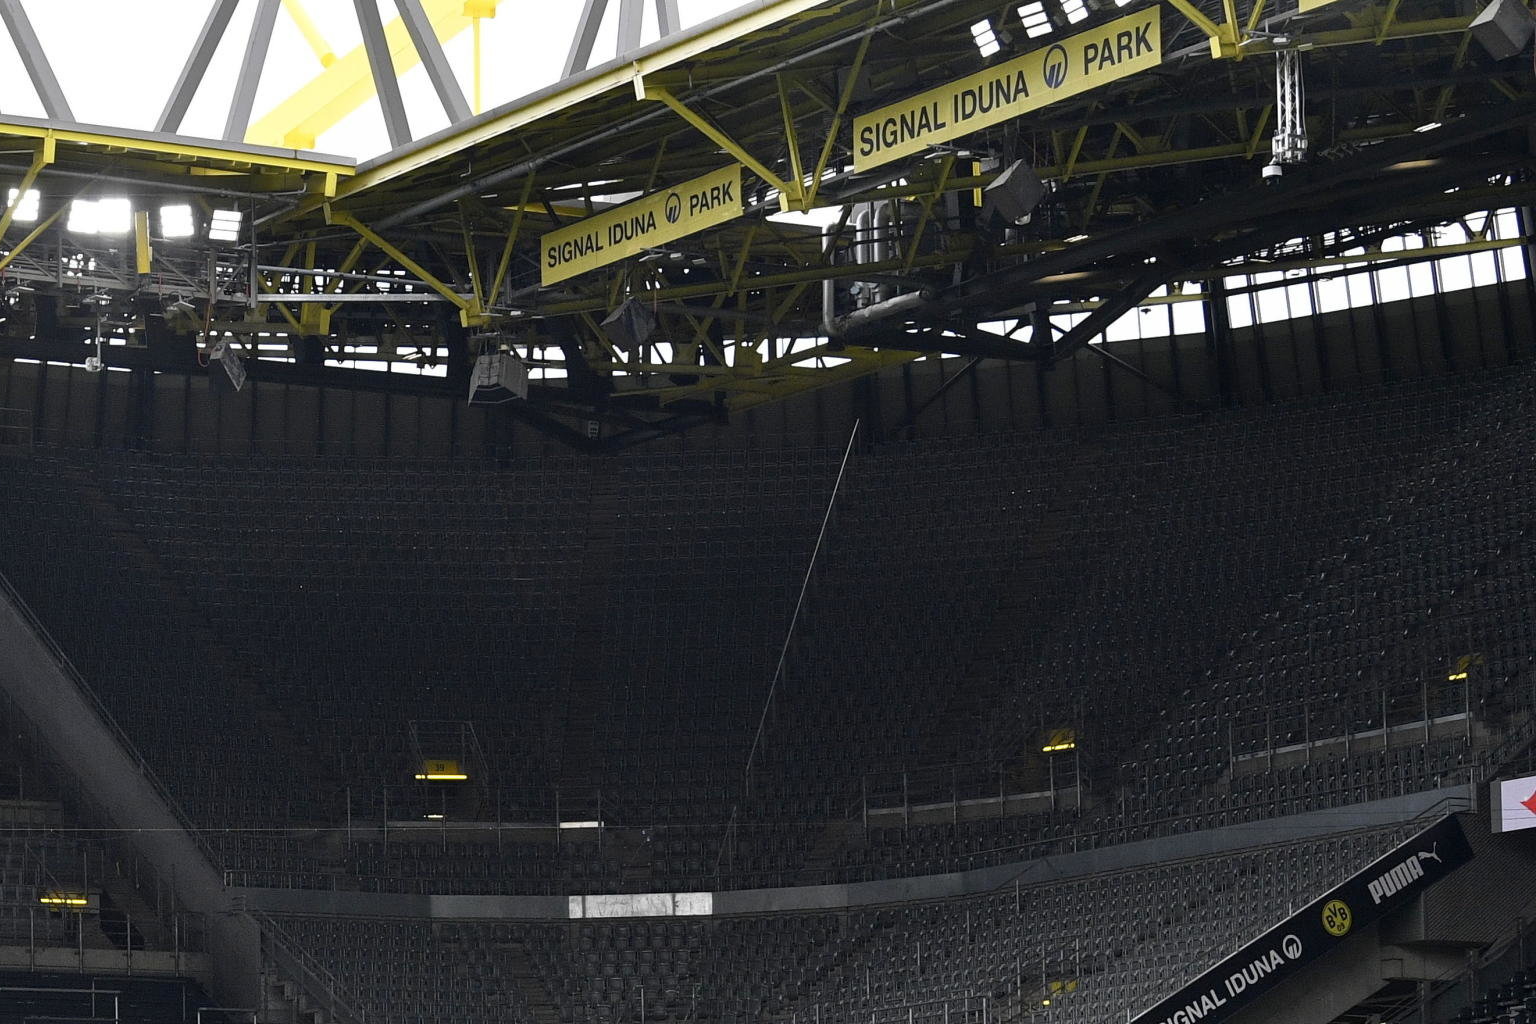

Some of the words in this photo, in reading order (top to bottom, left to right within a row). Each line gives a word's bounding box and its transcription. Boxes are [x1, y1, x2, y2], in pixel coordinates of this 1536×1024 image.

[860, 102, 946, 157] SIGNAL
[954, 70, 1029, 124] IDUNA
[1083, 22, 1153, 76] PARK
[547, 231, 604, 268] SIGNAL
[608, 211, 657, 247] IDUNA
[690, 180, 733, 216] PARK
[1367, 855, 1424, 905] PUMA
[1325, 903, 1349, 929] BVB
[1224, 949, 1285, 998] IDUNA
